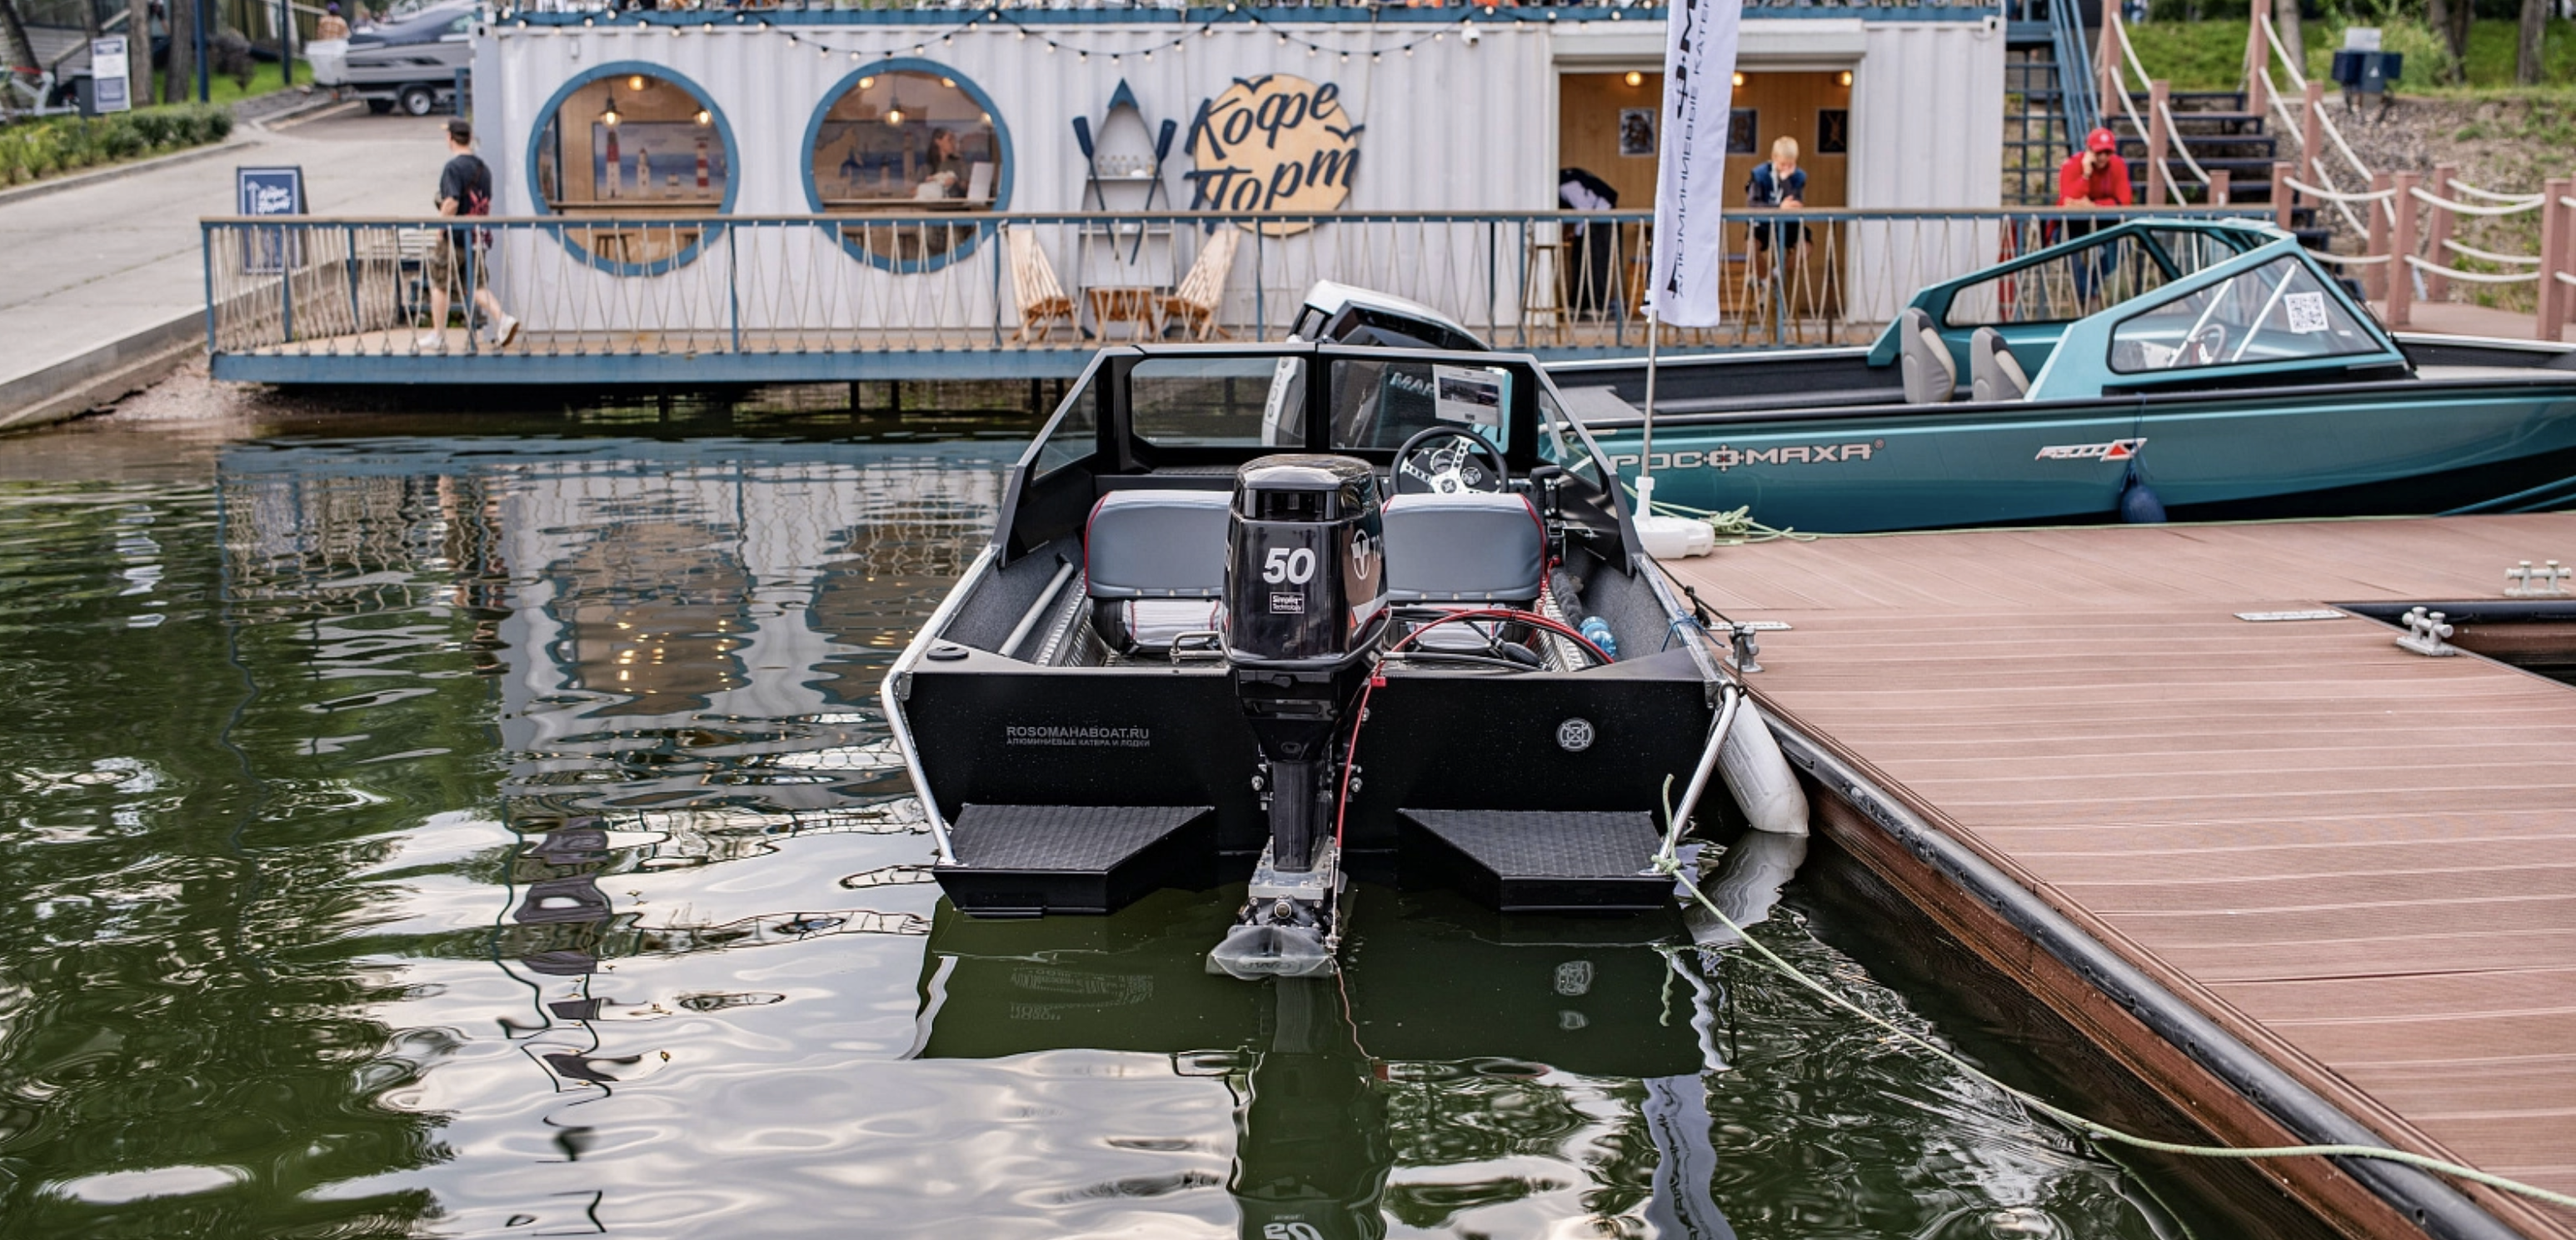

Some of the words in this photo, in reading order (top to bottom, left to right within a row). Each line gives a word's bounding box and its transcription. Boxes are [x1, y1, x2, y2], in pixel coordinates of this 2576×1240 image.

[1184, 82, 1340, 161] Кофе
[1182, 148, 1361, 235] Порт
[1262, 548, 1315, 584] 50
[1006, 726, 1150, 739] ROSOMAHABOAT.RU
